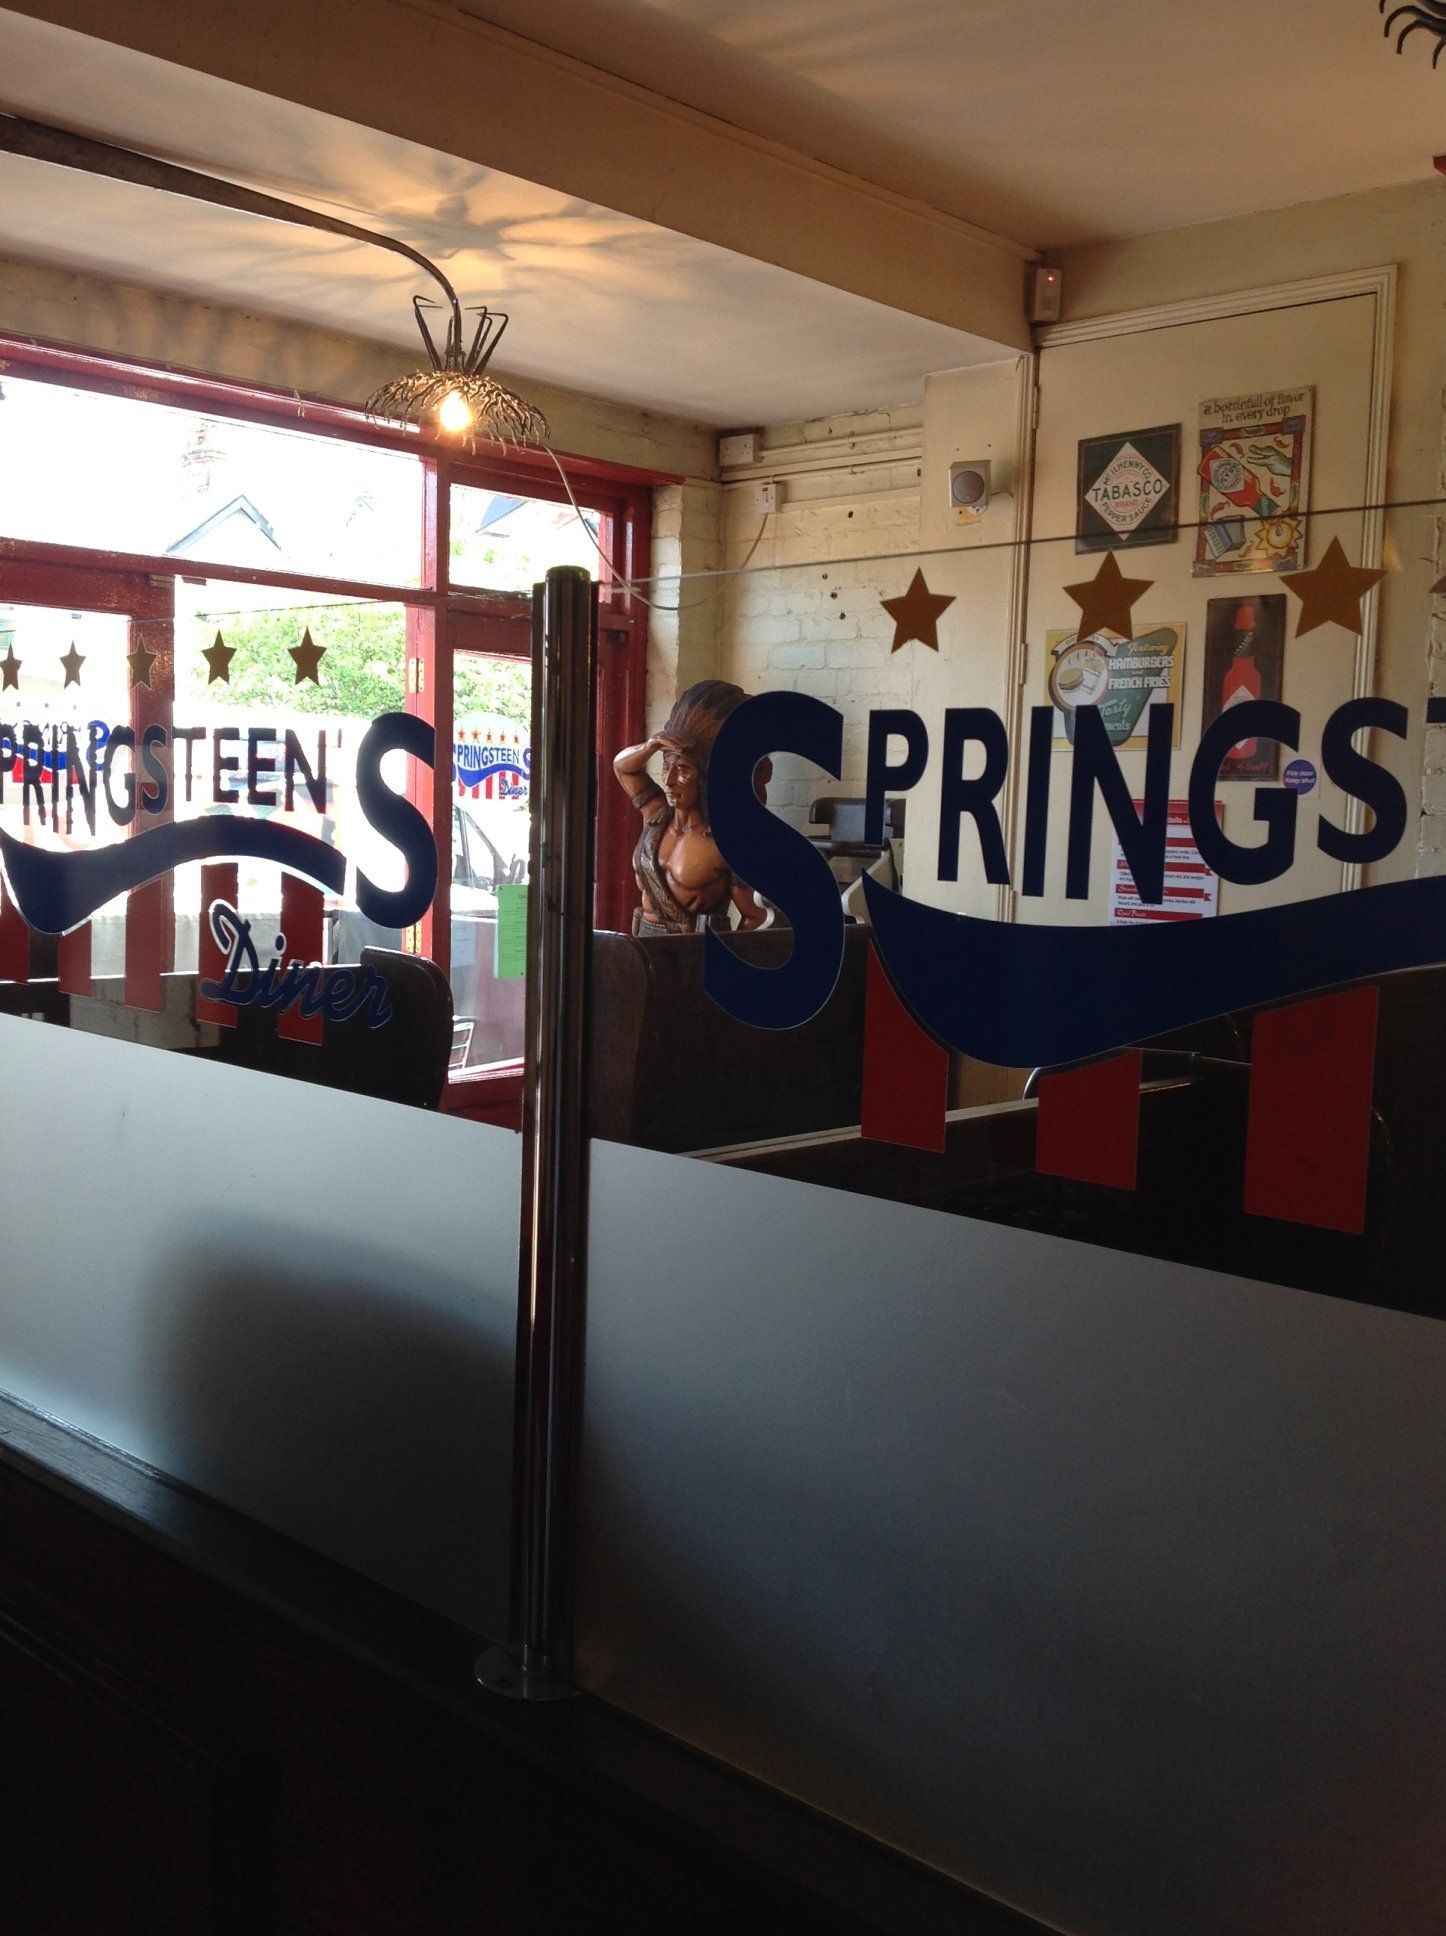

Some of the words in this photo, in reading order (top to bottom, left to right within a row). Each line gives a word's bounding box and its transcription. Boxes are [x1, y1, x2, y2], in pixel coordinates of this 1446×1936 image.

[1235, 408, 1263, 421] every
[1266, 405, 1290, 417] drop
[1092, 478, 1163, 502] TABASCO
[1103, 501, 1127, 522] PEPPER
[1129, 497, 1152, 522] SAUCE
[1127, 641, 1170, 656] Featuring
[1108, 655, 1175, 670] HAMBURGERS
[1108, 677, 1142, 690] FRENCH
[1143, 675, 1172, 689] FRIES
[499, 778, 528, 796] Diner
[704, 690, 1446, 1031] SPRINGS
[200, 898, 393, 1029] Diner
